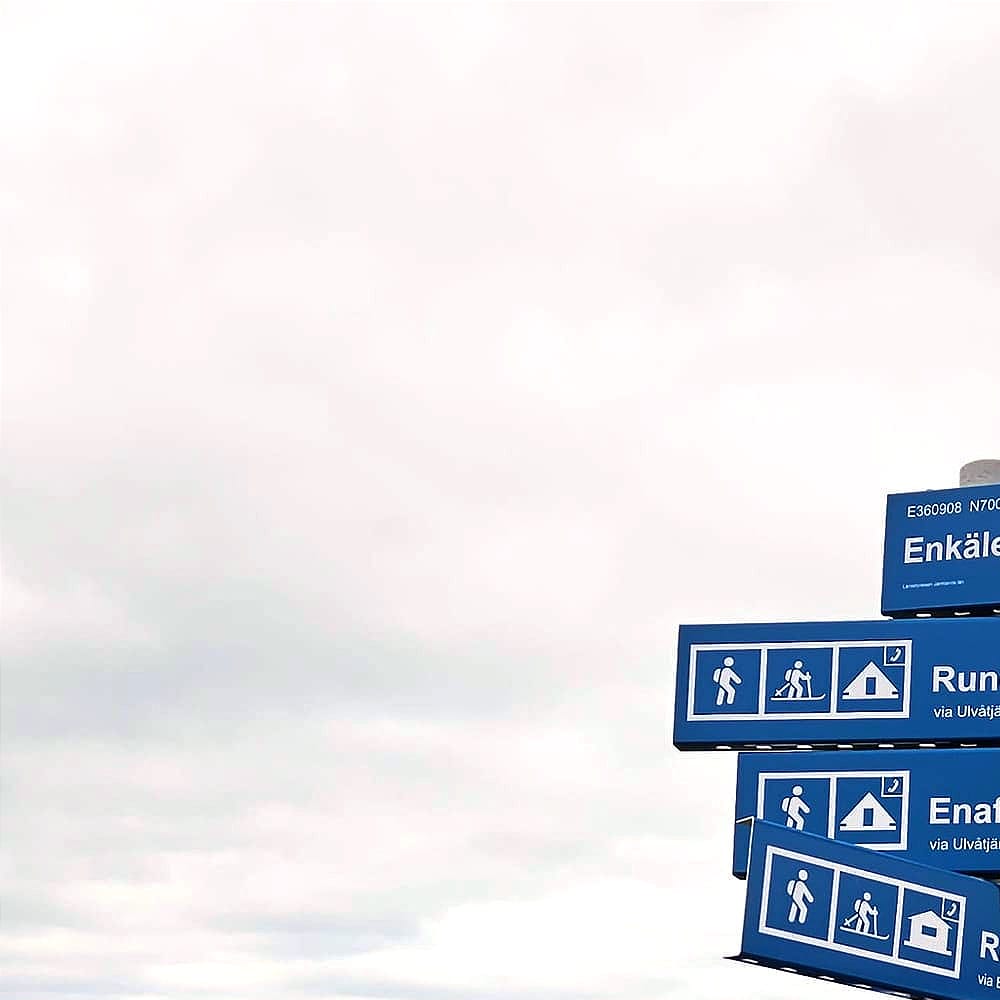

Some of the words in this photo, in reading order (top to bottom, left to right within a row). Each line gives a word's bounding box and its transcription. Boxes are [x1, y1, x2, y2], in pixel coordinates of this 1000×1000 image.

[907, 501, 962, 518] E360908
[933, 705, 953, 718] via
[929, 840, 949, 851] via
[977, 974, 994, 987] via
